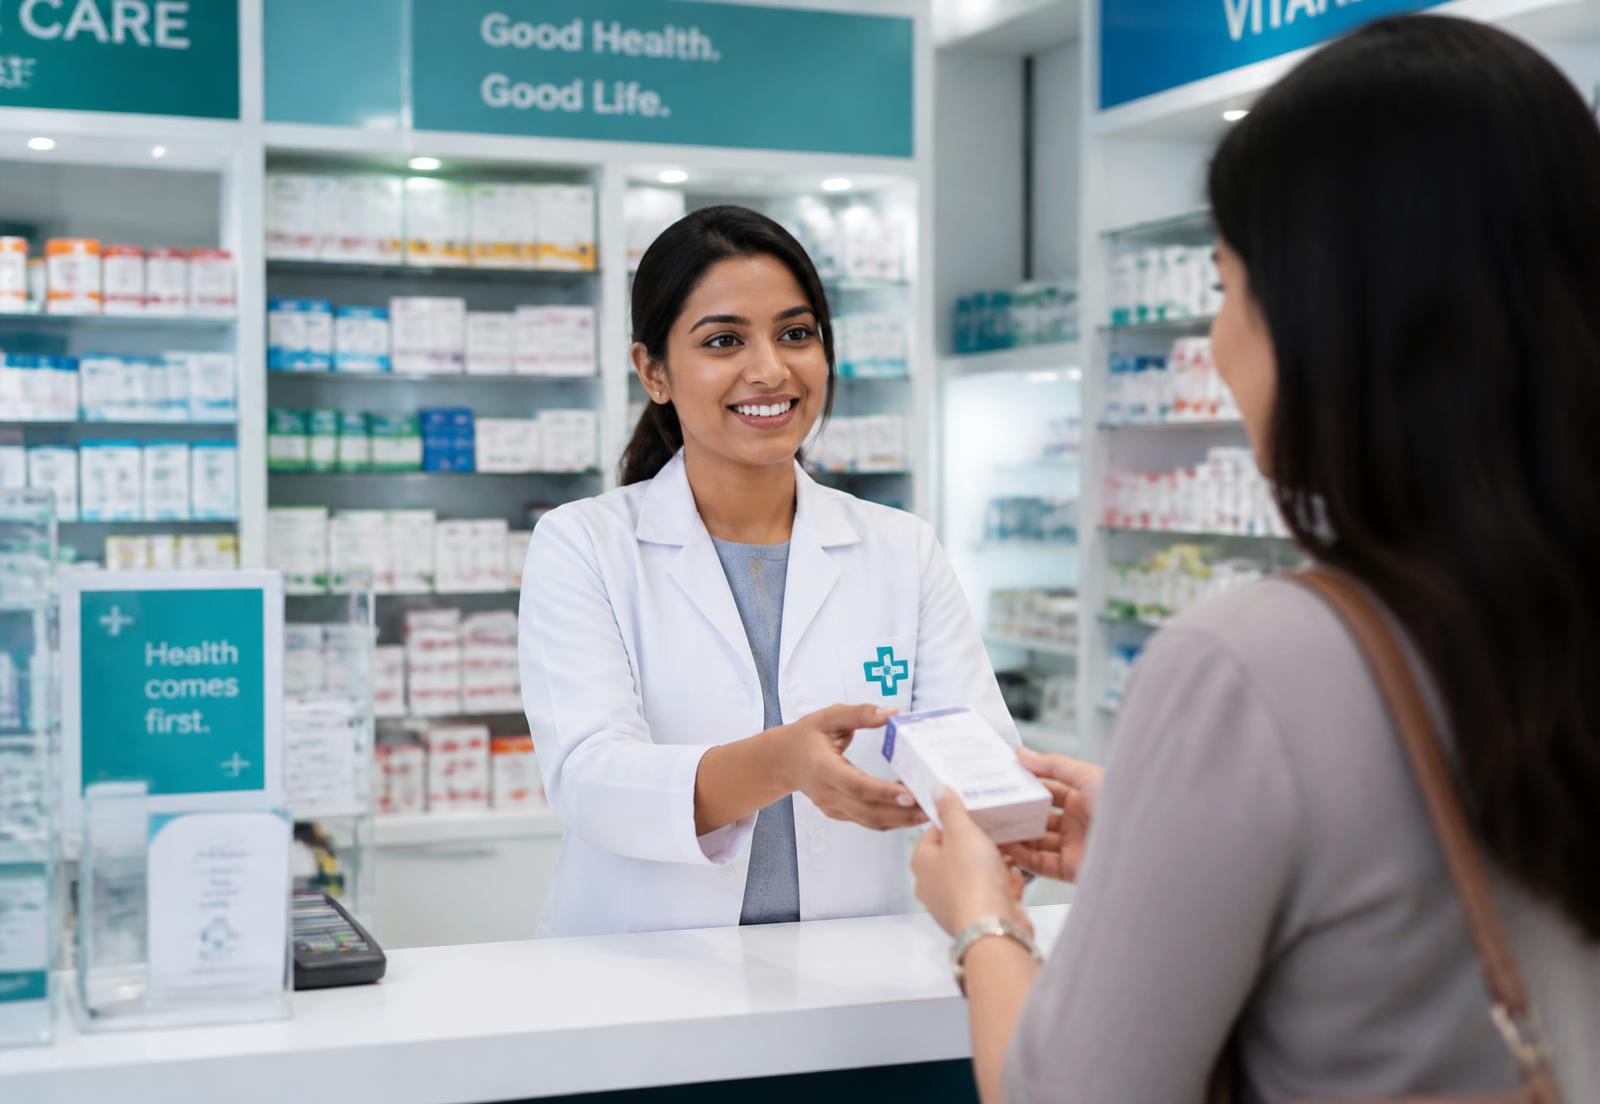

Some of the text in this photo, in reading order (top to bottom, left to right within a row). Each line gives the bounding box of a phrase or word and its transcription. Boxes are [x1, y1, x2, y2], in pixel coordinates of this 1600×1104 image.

[18, 0, 191, 49] CARE
[480, 12, 722, 62] Good Health.
[480, 72, 671, 118] Good Life.
[144, 639, 239, 667] Health
[144, 676, 240, 700] comes
[144, 707, 211, 735] first.
